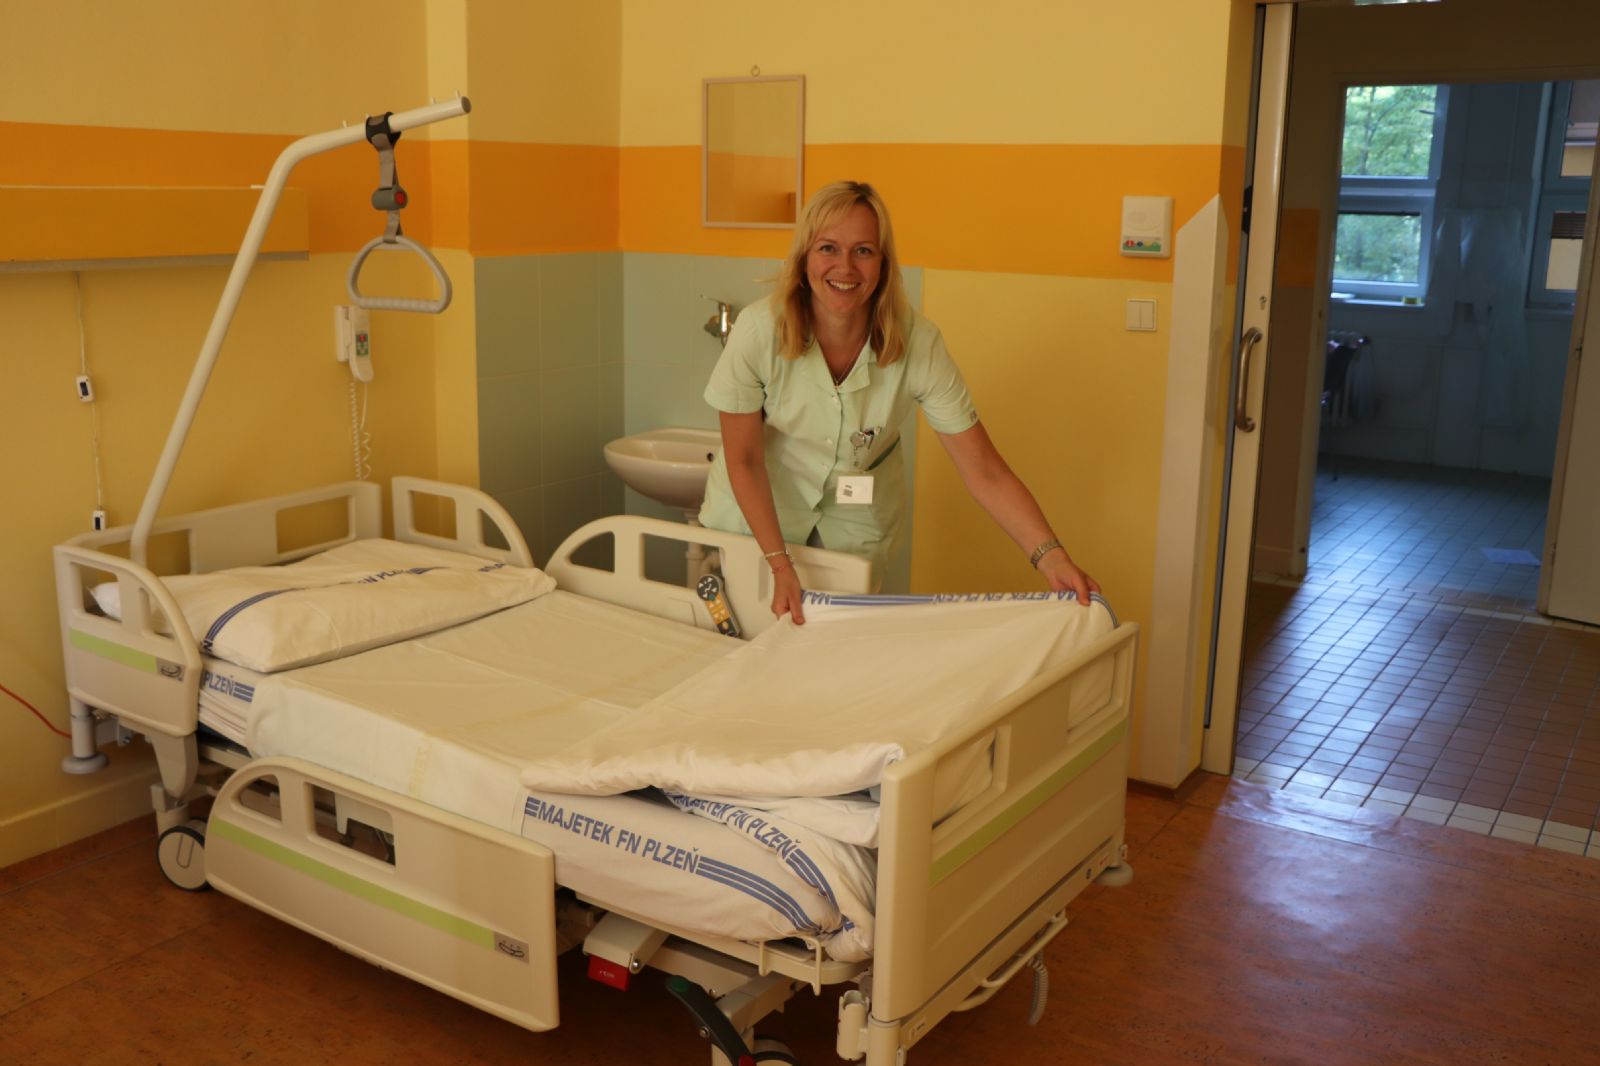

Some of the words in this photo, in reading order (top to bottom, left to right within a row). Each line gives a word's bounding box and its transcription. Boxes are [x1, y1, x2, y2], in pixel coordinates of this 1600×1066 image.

[538, 801, 614, 845] MAJETEK
[616, 829, 642, 854] FN
[642, 839, 698, 874] PLZEŇ
[727, 810, 753, 829] FN
[746, 818, 801, 860] PLZEŇ
